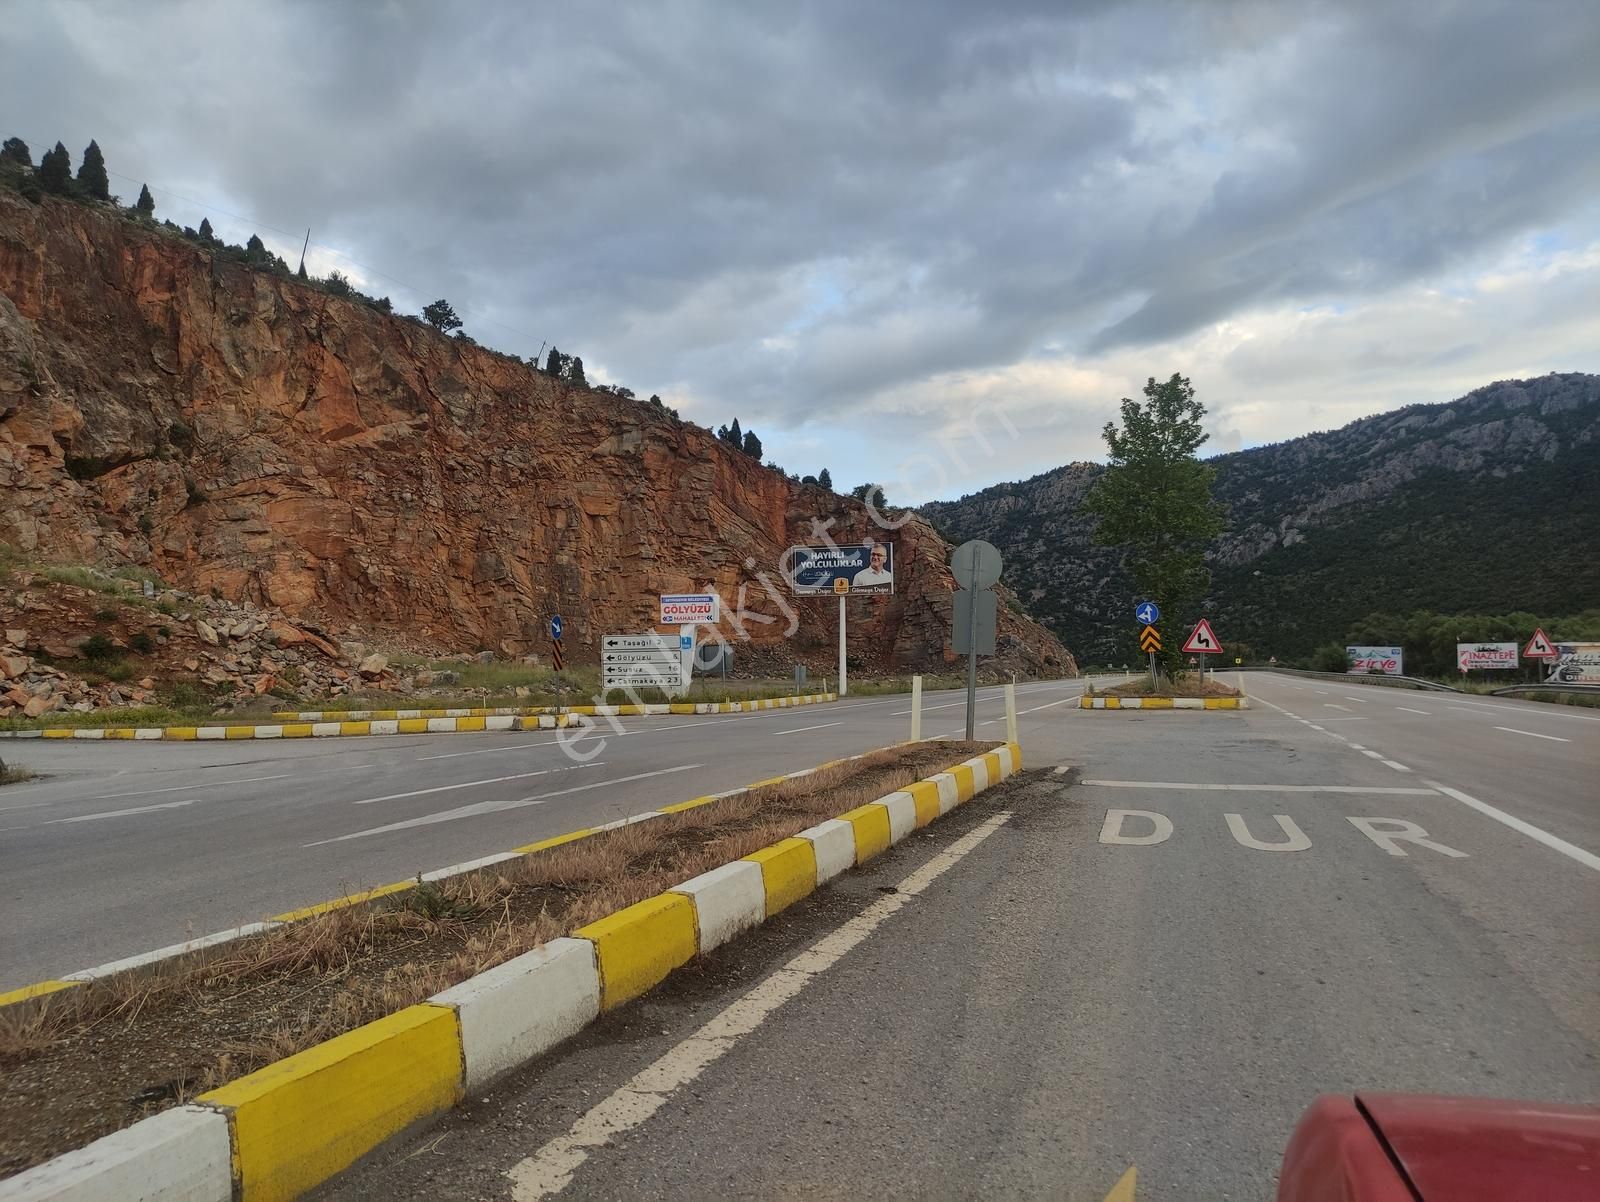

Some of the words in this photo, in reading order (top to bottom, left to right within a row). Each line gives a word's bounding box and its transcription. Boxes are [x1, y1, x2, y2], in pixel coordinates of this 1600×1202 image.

[811, 551, 845, 560] HAYIRLI
[800, 560, 863, 569] YOLCULUKLAR
[663, 603, 711, 614] GÖLYÜZÜ
[1355, 658, 1397, 669] zirve
[1098, 808, 1471, 858] DUR
